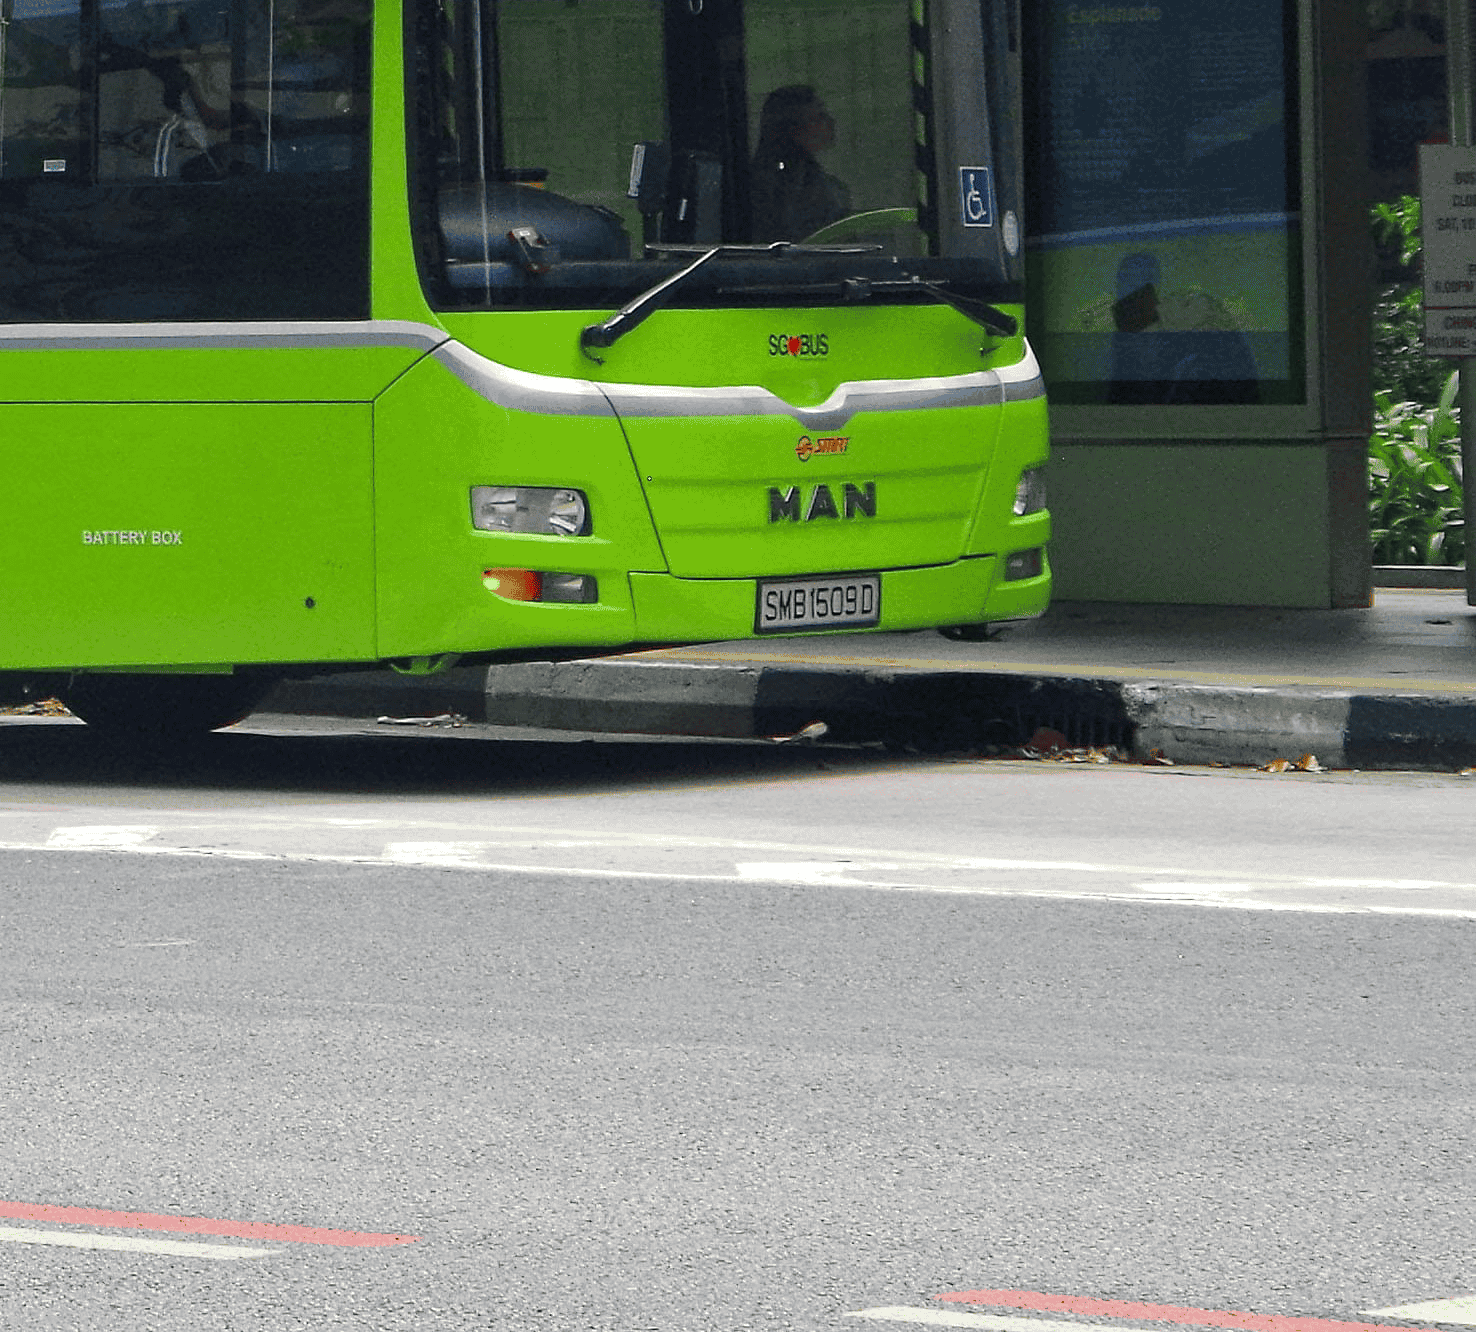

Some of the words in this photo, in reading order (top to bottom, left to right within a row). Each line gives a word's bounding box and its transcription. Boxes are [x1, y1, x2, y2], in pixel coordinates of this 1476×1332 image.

[768, 481, 877, 523] MAN
[82, 530, 147, 545] BATTERY
[151, 530, 182, 545] BOX
[765, 583, 873, 623] SMB1509D
